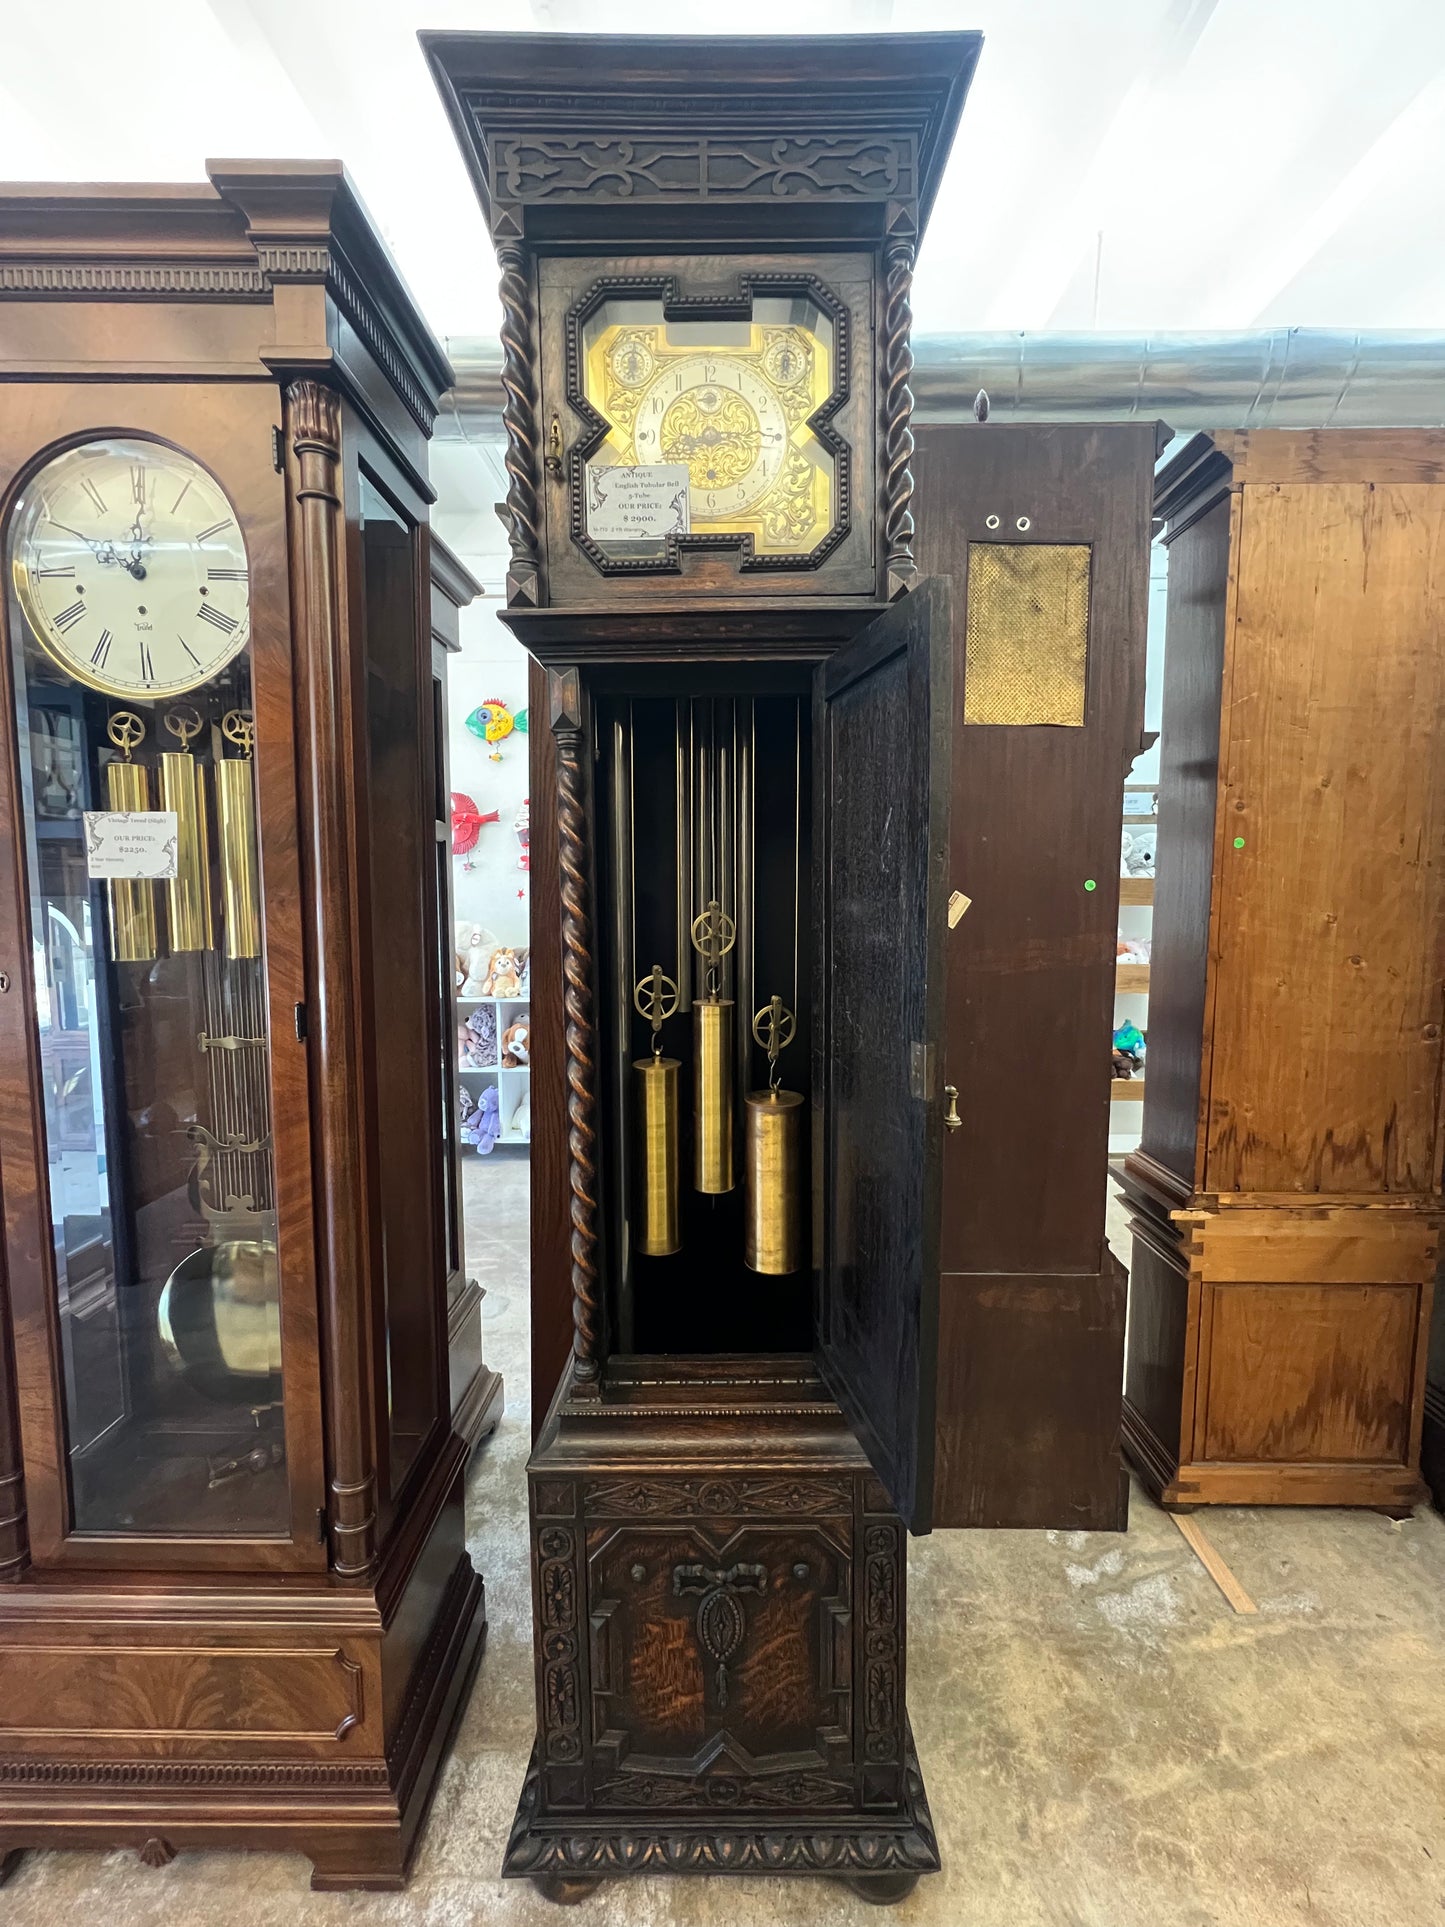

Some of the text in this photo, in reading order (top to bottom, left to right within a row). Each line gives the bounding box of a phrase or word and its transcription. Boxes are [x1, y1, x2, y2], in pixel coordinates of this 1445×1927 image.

[704, 365, 717, 383] 12
[652, 397, 664, 415] 10
[758, 396, 767, 413] 2
[646, 429, 656, 445] 9
[621, 471, 653, 479] ANTIQUE
[757, 459, 768, 477] 4
[614, 482, 639, 490] English
[736, 482, 746, 500] 5
[706, 492, 716, 509] 6
[623, 515, 657, 524] $ 2900.
[118, 846, 147, 854] $2250.
